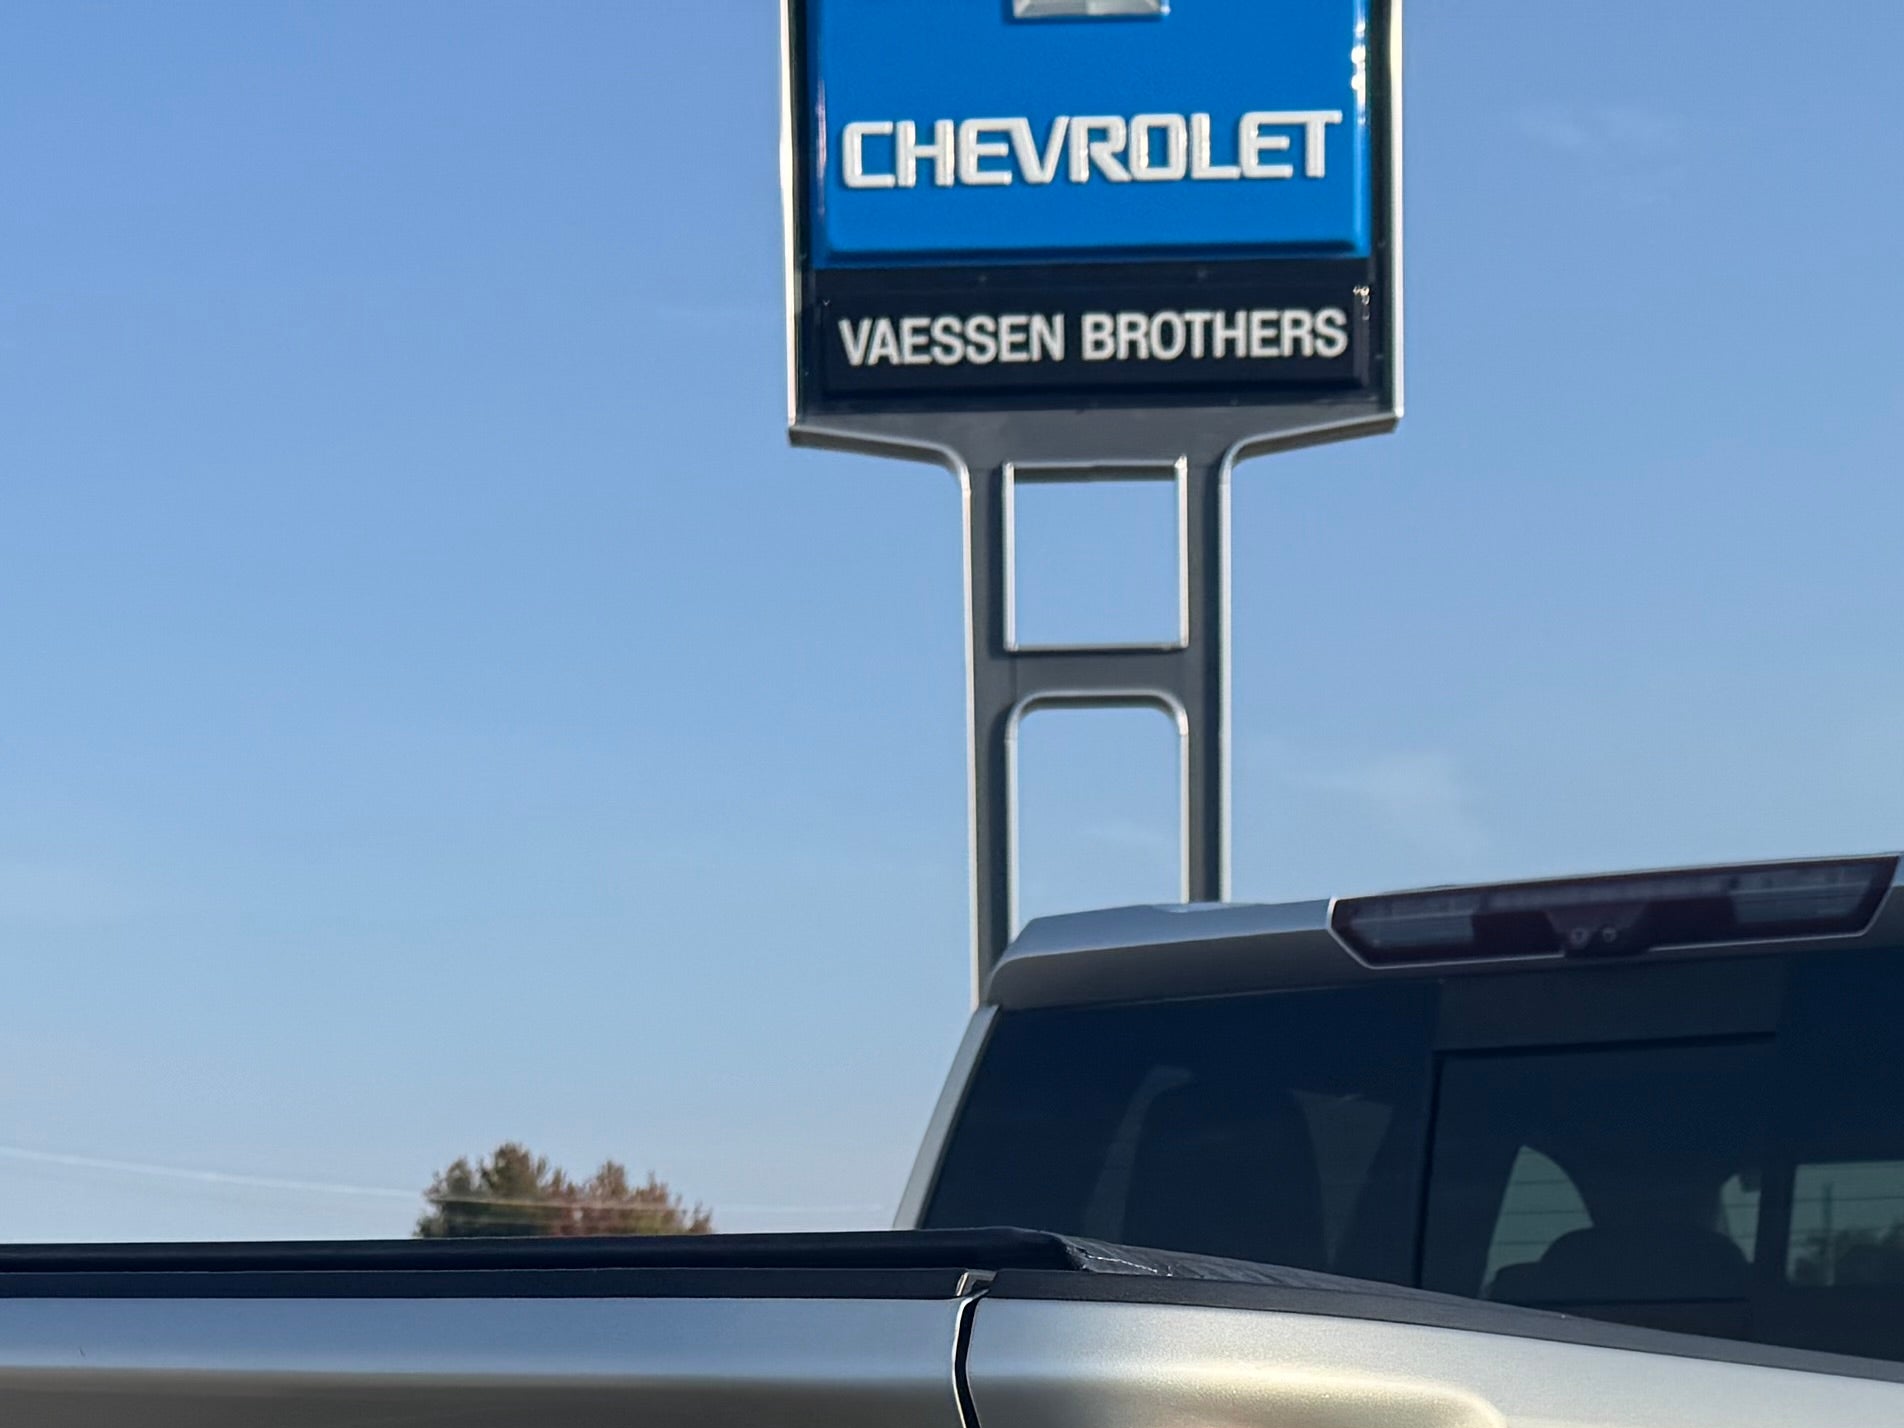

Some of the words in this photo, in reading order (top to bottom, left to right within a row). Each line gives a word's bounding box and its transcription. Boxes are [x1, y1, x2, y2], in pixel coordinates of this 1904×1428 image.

[842, 109, 1343, 189] CHEVROLET
[839, 314, 1065, 366] VAESSEN
[1081, 308, 1348, 361] BROTHERS
